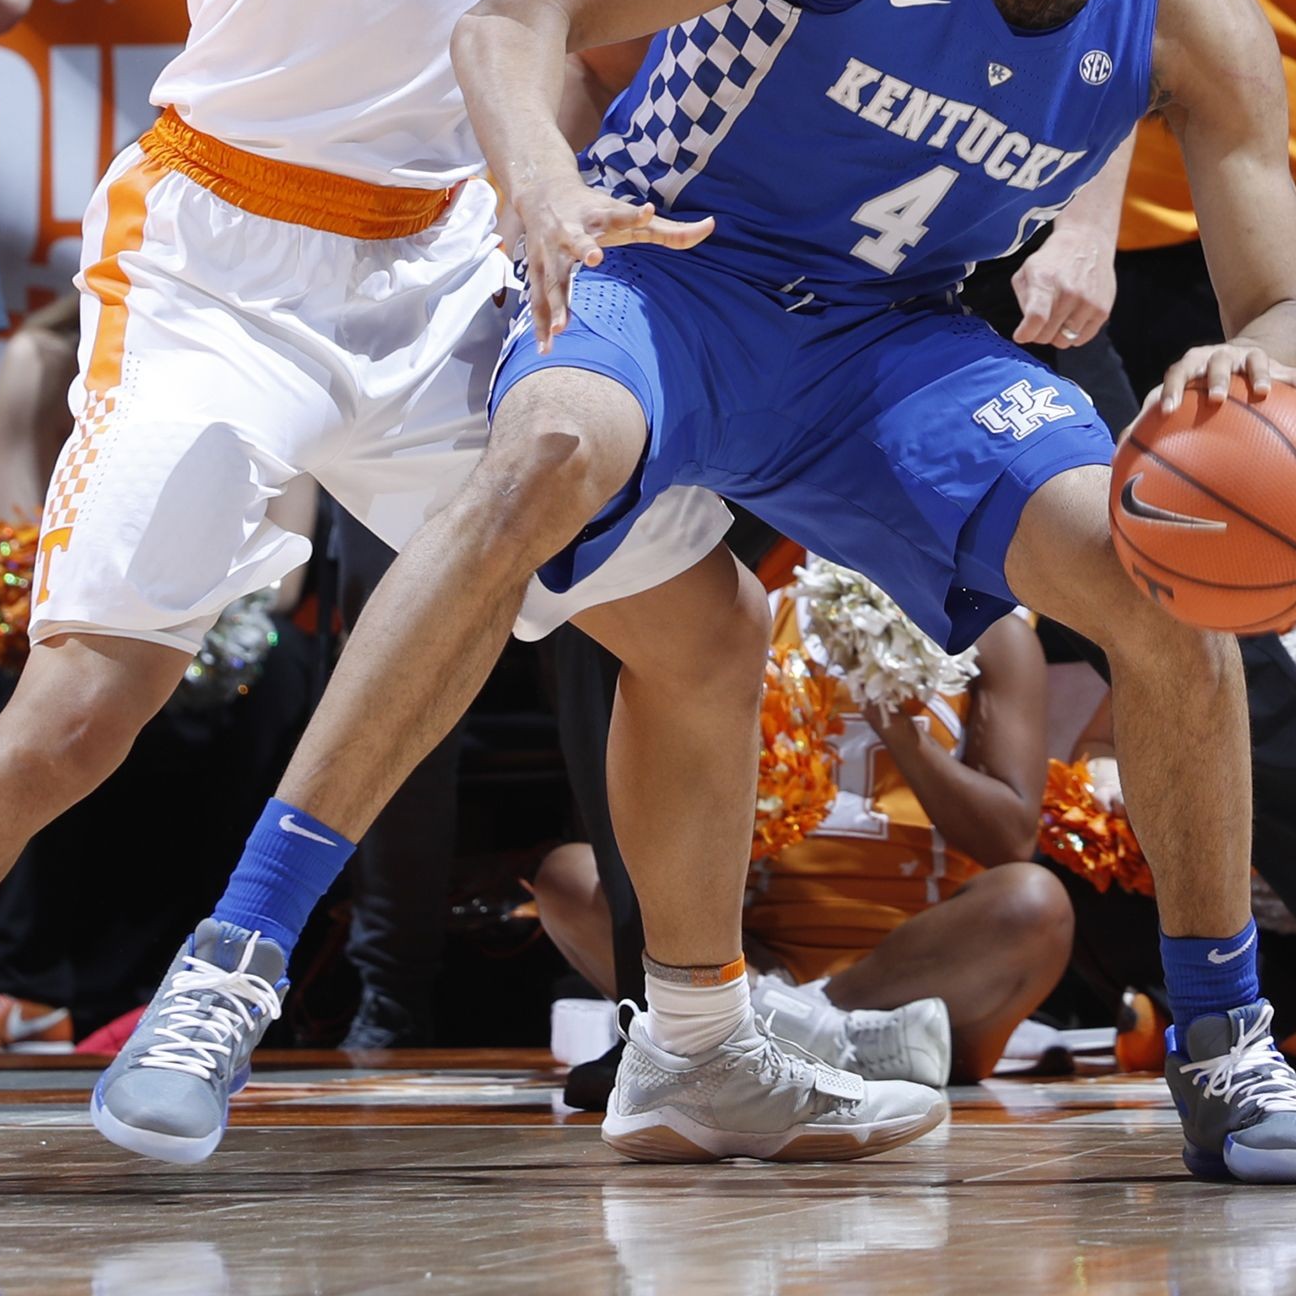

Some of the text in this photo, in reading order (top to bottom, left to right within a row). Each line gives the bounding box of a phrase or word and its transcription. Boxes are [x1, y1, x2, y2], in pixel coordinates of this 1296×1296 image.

[1081, 52, 1111, 84] SEC
[849, 164, 960, 275] 4
[972, 379, 1076, 441] UK
